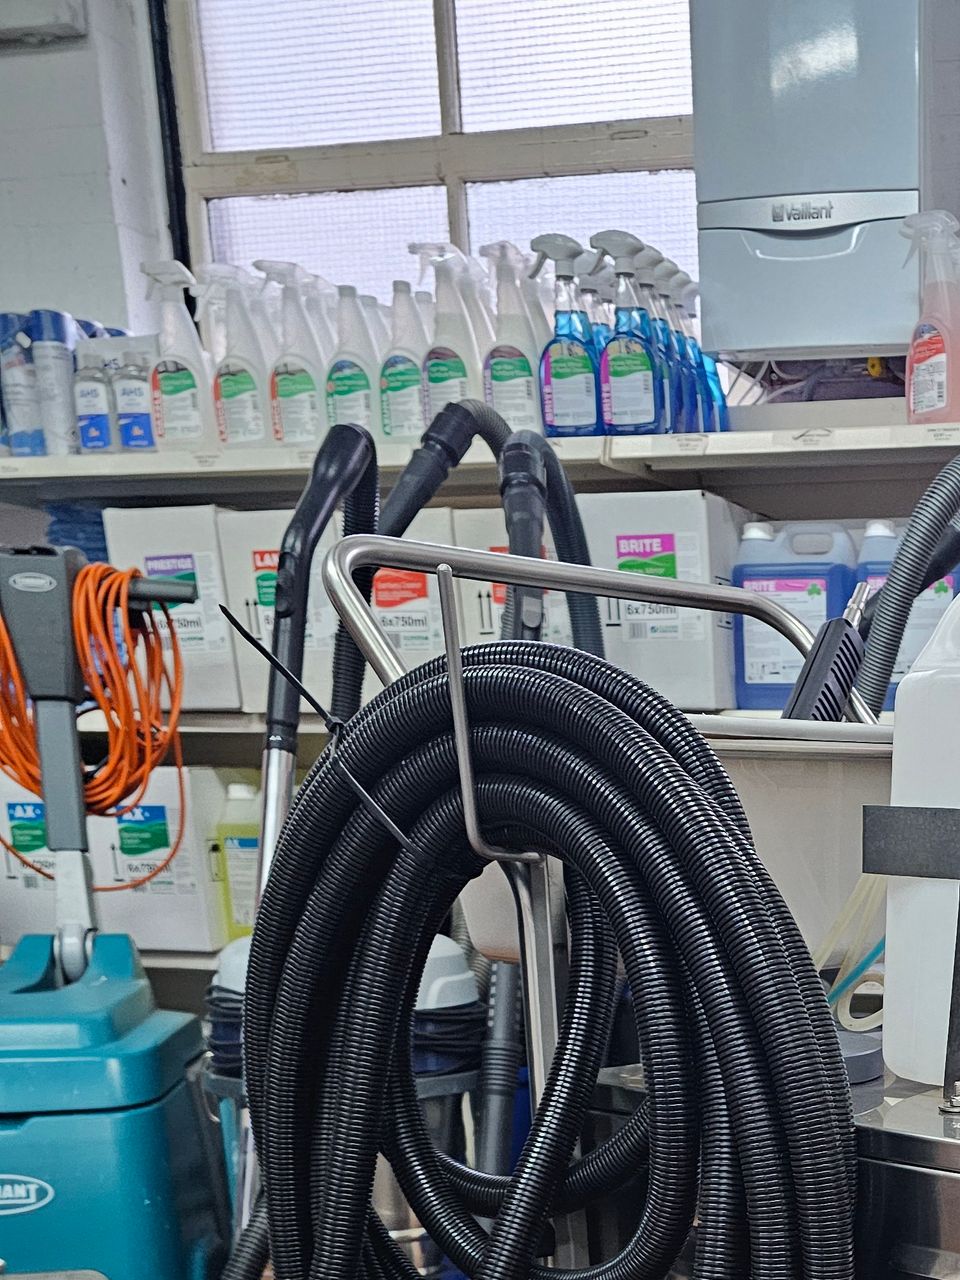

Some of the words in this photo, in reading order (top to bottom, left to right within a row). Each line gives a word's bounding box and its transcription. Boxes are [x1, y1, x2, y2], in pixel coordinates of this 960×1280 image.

[786, 201, 834, 221] Vaillant
[619, 538, 662, 553] BRITE
[254, 552, 279, 567] LAN
[380, 616, 427, 628] 6x750ml
